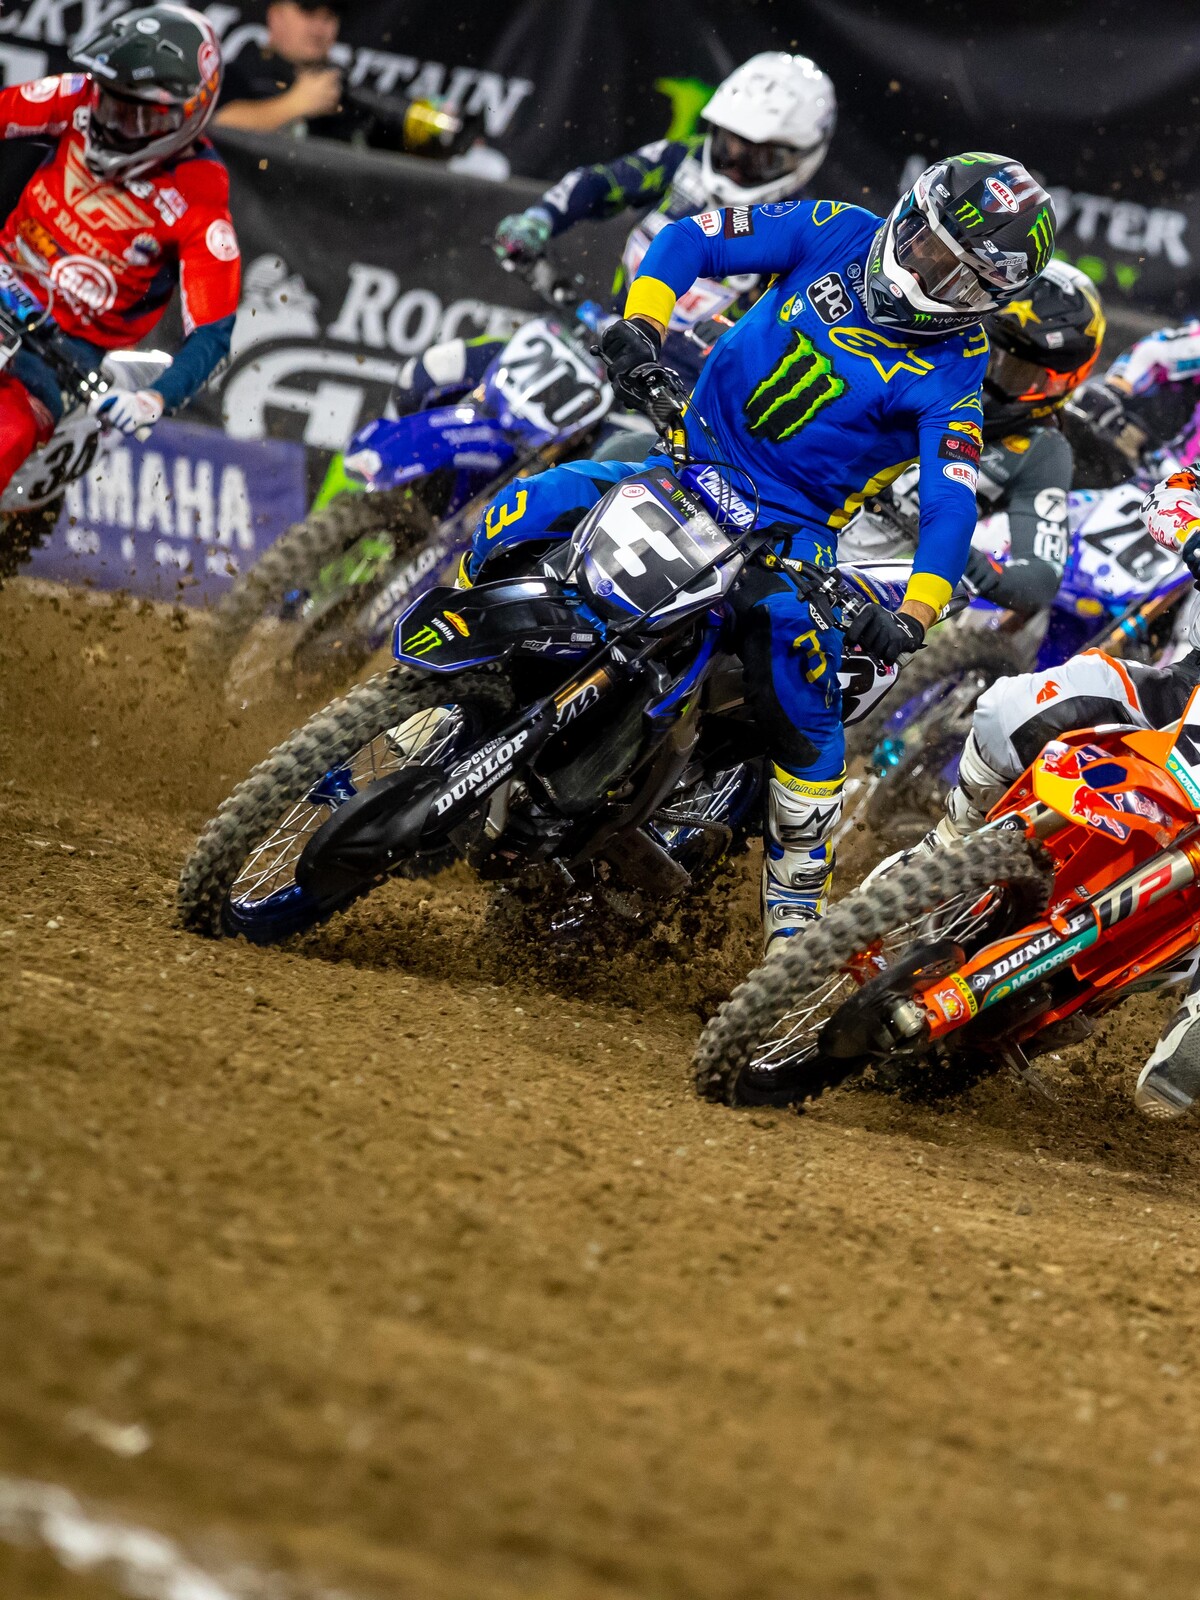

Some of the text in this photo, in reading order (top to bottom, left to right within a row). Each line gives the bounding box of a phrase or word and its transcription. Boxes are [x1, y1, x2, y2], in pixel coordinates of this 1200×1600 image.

[990, 182, 1013, 208] BELL
[701, 213, 715, 231] ELL
[813, 276, 848, 321] PPG
[430, 617, 455, 642] YAMAHA
[434, 729, 529, 817] DUNLOP
[780, 778, 836, 798] Alpinestars
[991, 913, 1087, 981] DUNLP
[1012, 942, 1083, 991] MOTOREX
